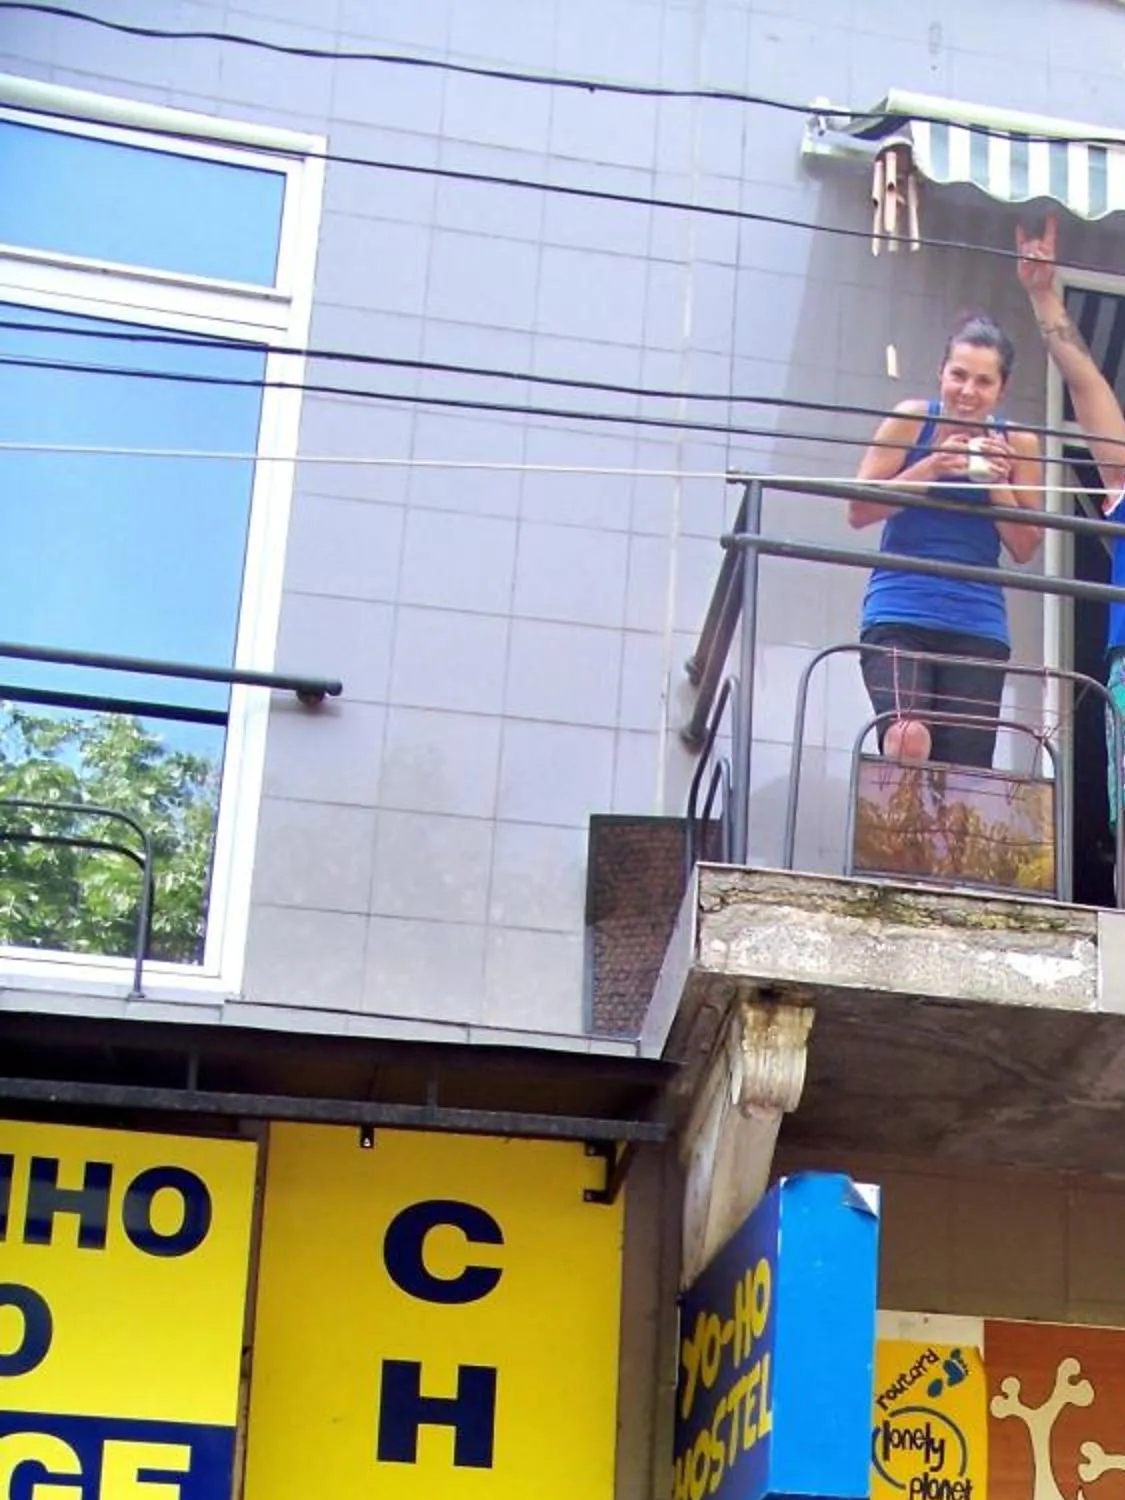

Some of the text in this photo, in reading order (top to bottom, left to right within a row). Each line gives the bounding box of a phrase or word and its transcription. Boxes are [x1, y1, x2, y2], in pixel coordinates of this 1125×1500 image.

[0, 1153, 212, 1258] НО
[876, 1348, 940, 1411] routard
[883, 1419, 945, 1472] lonely
